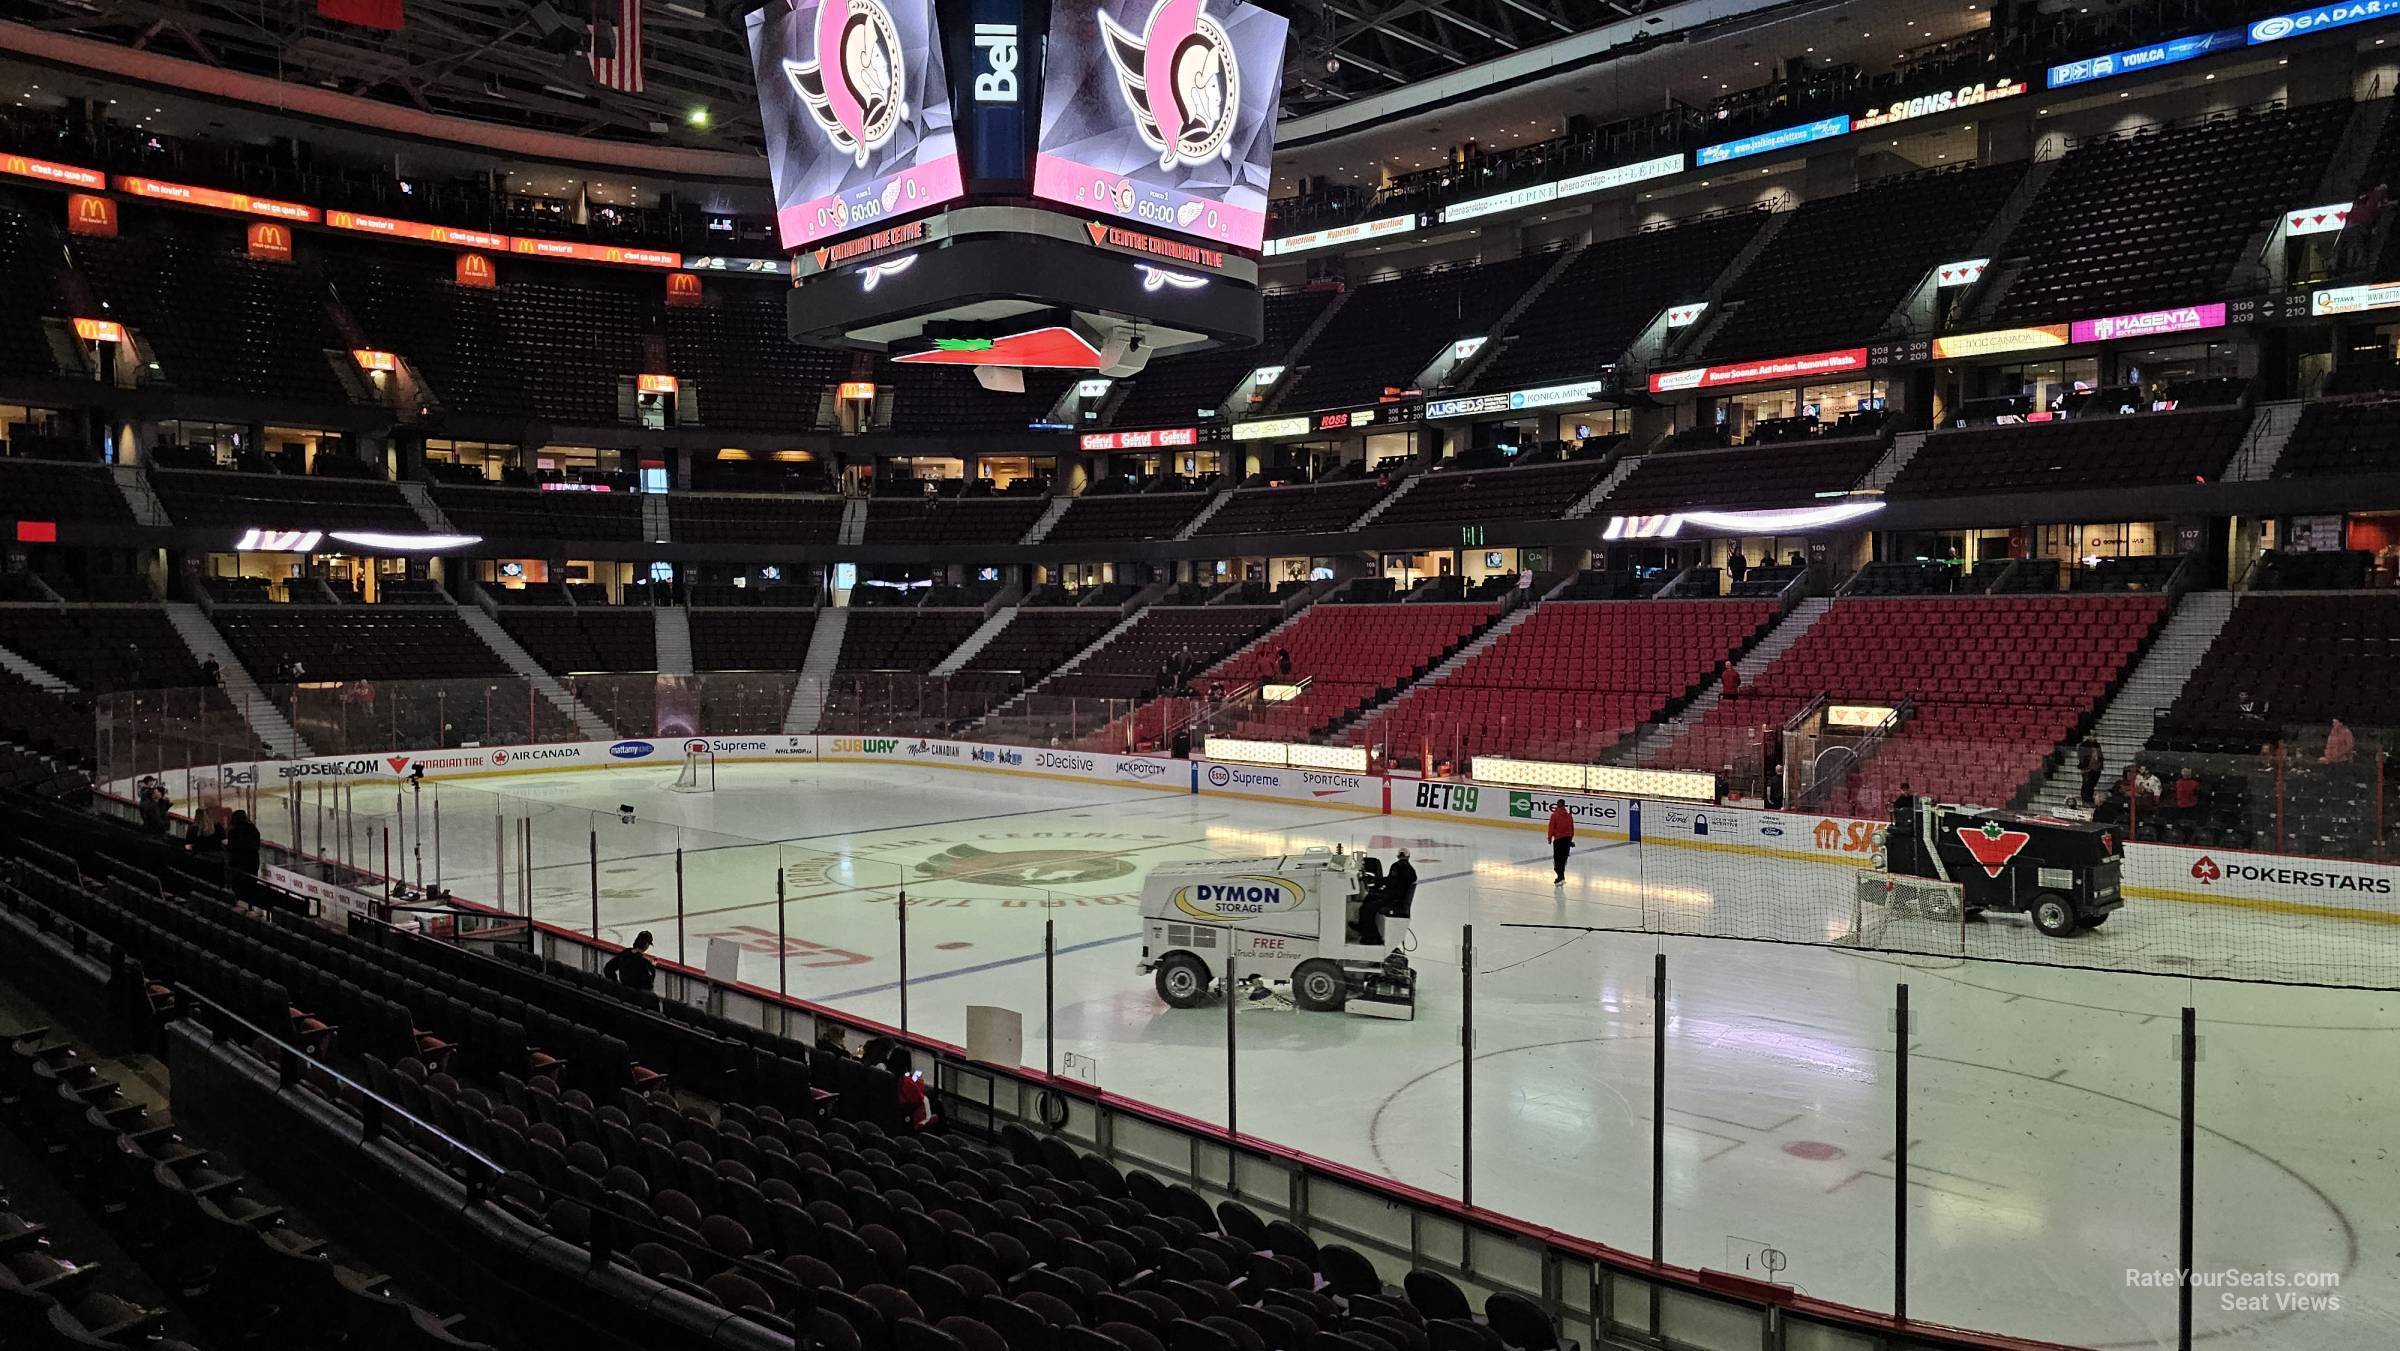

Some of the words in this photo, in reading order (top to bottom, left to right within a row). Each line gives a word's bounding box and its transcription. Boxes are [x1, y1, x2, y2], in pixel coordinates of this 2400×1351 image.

[2294, 0, 2380, 29] GADAR
[975, 23, 1018, 102] Bell
[2122, 49, 2165, 67] YOW.CA
[1889, 83, 1985, 122] SIGNS.CA
[1632, 158, 1682, 179] LÉPINE
[906, 178, 917, 199] 0
[1093, 180, 1104, 200] 0
[1509, 186, 1556, 206] LÉPINE
[817, 208, 827, 227] 0
[851, 198, 881, 223] 60:00
[1138, 200, 1174, 224] 60:00
[1207, 210, 1218, 229] 0
[1369, 217, 1405, 233] Hyperline
[831, 236, 871, 261] CANADIAN
[872, 230, 890, 249] TIRE
[890, 221, 922, 244] CENTRE
[1285, 234, 1318, 249] Hyperline
[1327, 227, 1360, 242] Hyperline
[1110, 227, 1147, 251] CENTRE
[1148, 236, 1199, 262] CANADIAN
[1200, 249, 1223, 268] TIRE
[2232, 301, 2254, 311] 309
[2286, 295, 2306, 305] 310
[2116, 309, 2200, 330] MAGENTA
[2232, 314, 2254, 322] 209
[2286, 307, 2306, 317] 210
[2116, 325, 2153, 337] EXTERIOR
[1872, 347, 1888, 356] 308
[1910, 342, 1927, 351] 309
[1910, 352, 1927, 361] 209
[1710, 372, 1731, 382] Know
[1732, 368, 1759, 379] Sooner.
[1760, 366, 1772, 375] Act
[1773, 363, 1796, 373] Faster.
[1797, 359, 1829, 371] Remove
[1830, 356, 1856, 367] Waste.
[1528, 394, 1560, 404] KONICA
[1428, 399, 1475, 417] ALIGNED
[1321, 414, 1347, 427] ROSS
[1120, 432, 1151, 447] Gabriel
[1159, 430, 1190, 444] Gabriel
[2181, 531, 2199, 539] 107
[714, 741, 766, 756] Supreme
[831, 740, 899, 758] SUBWAY
[931, 744, 960, 757] CANADIAN
[463, 757, 484, 770] TIRE
[511, 752, 530, 766] AIR
[532, 748, 581, 763] CANADA
[1046, 753, 1093, 777] Decisive
[1115, 762, 1166, 774] JACKPOTCITY
[1211, 770, 1227, 781] Esso
[1232, 771, 1279, 787] Supreme
[1416, 782, 1478, 813] BET99
[977, 831, 1137, 839] CENTRE
[2226, 864, 2391, 894] POKERSTARS
[1196, 884, 1280, 904] DYMON
[1215, 902, 1263, 914] STORAGE
[1254, 938, 1284, 950] FREE
[1258, 950, 1275, 959] and
[1276, 950, 1302, 960] Driver
